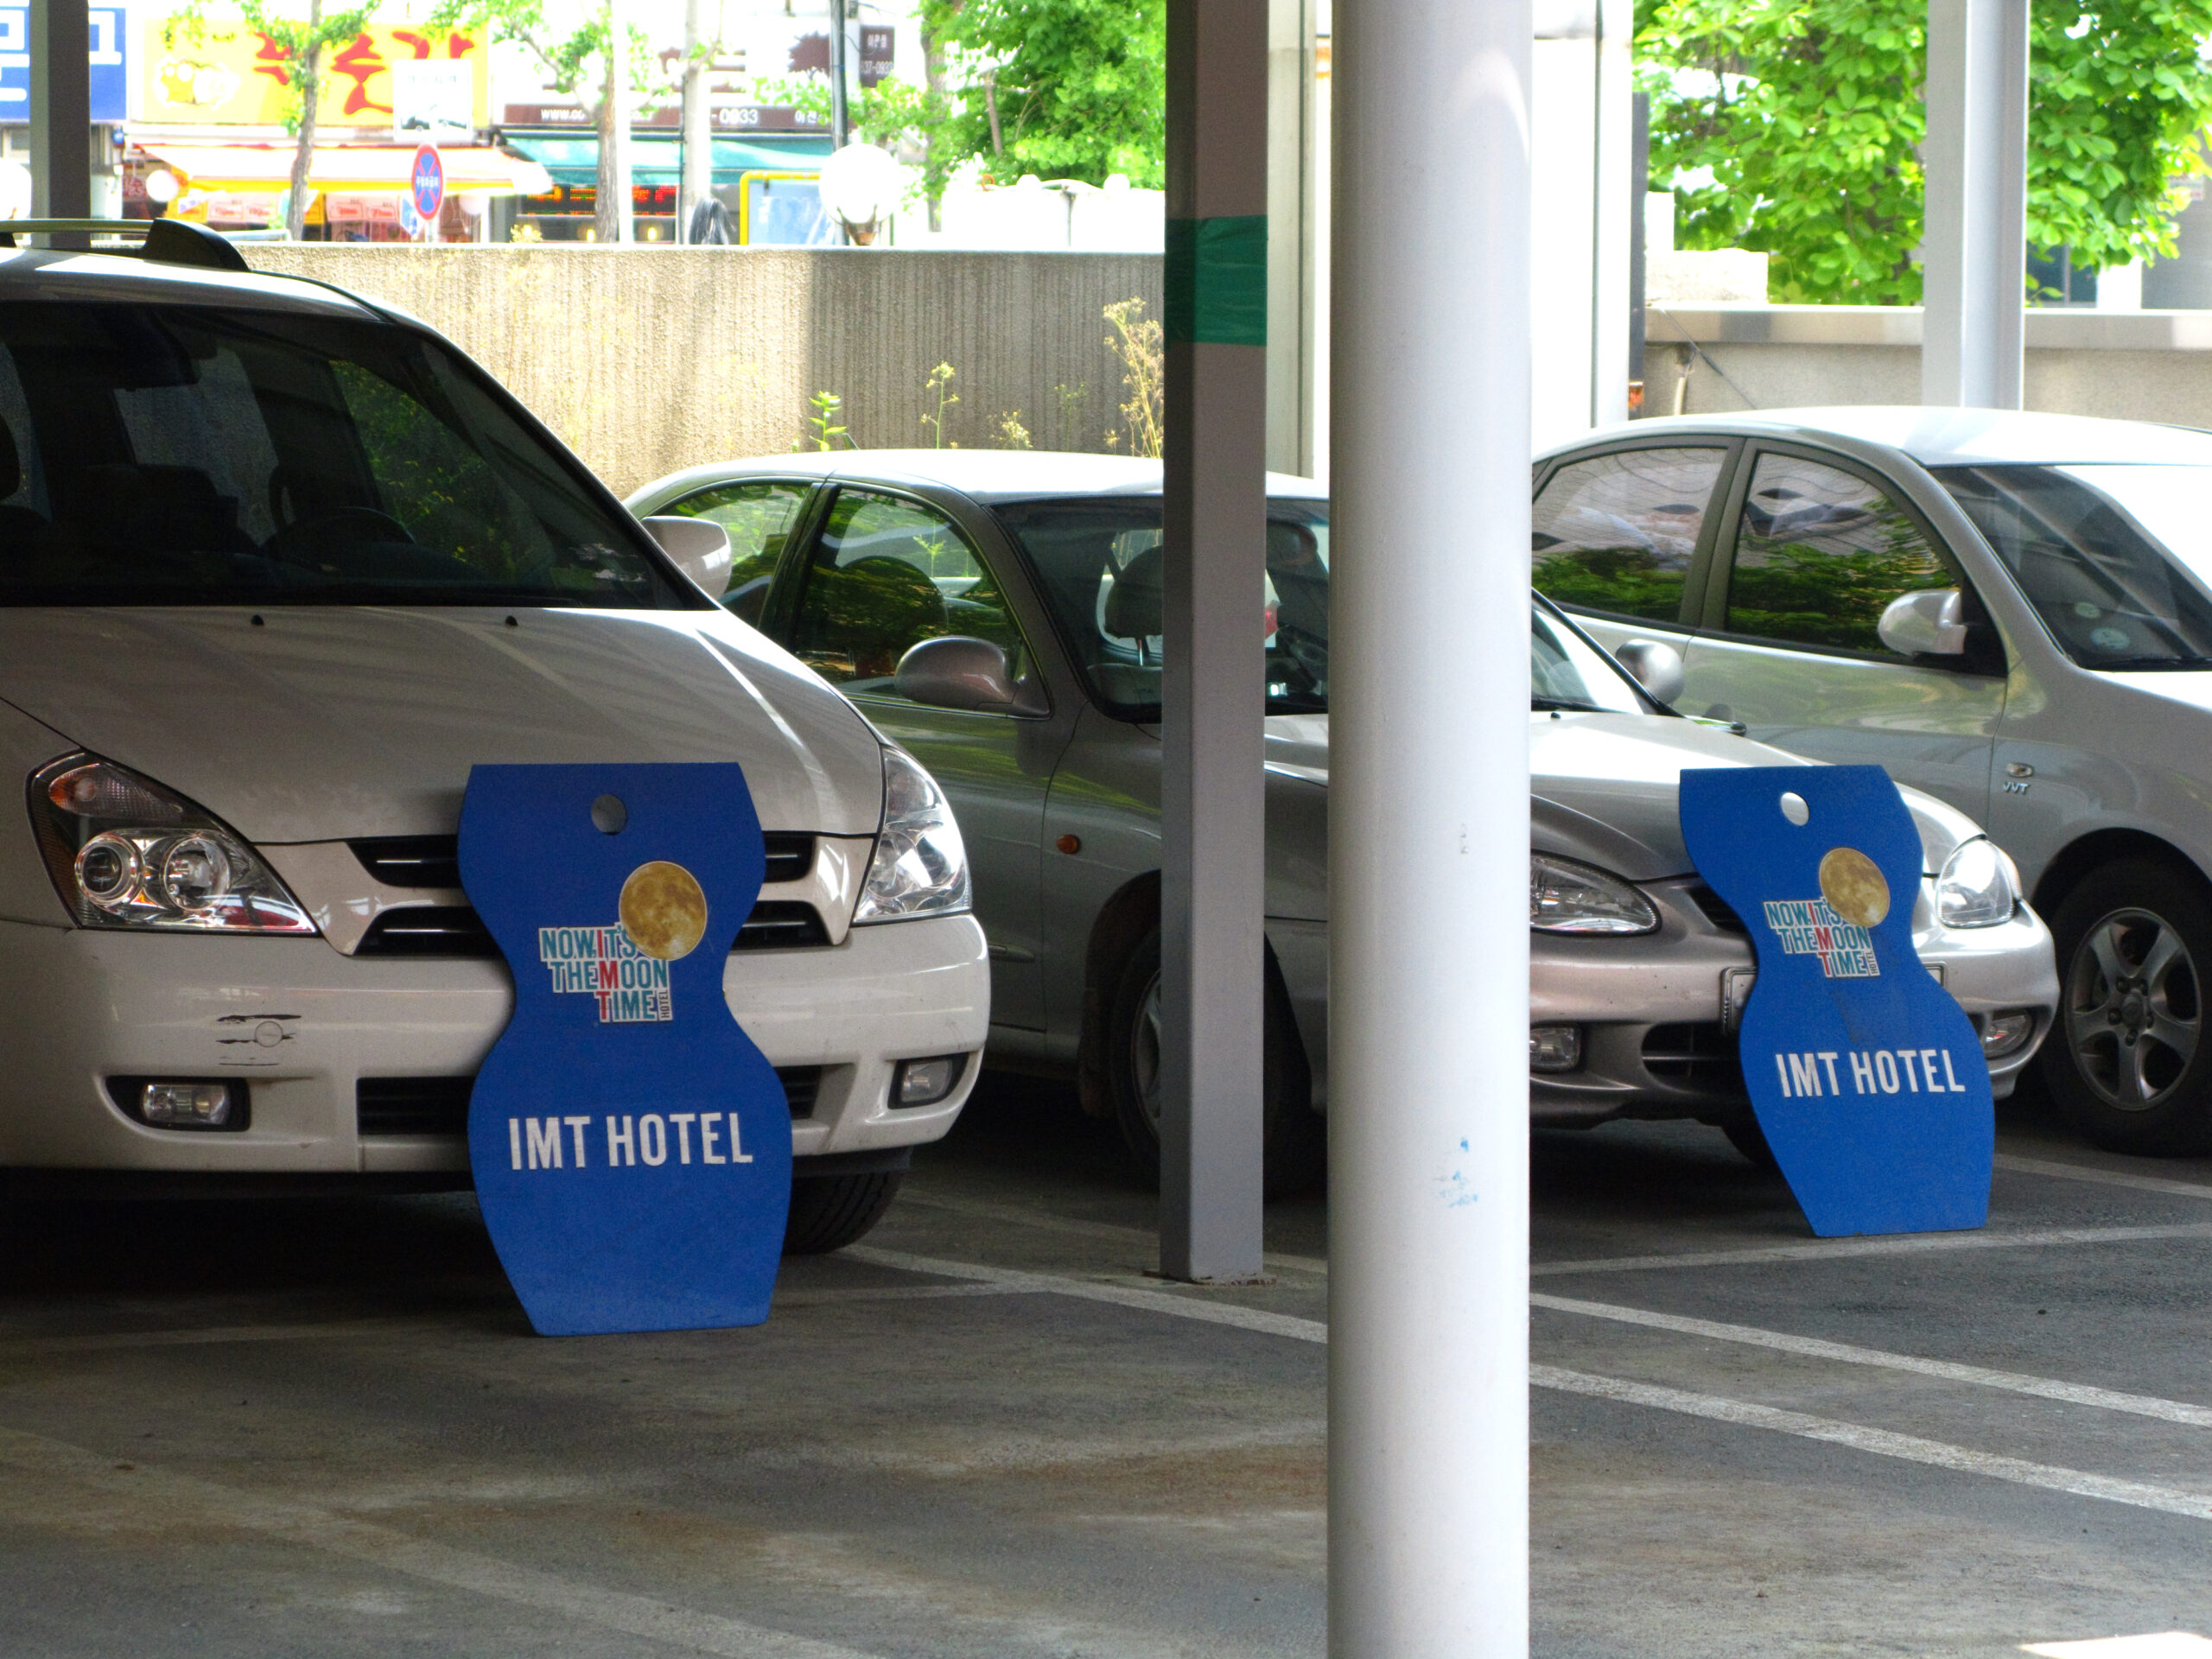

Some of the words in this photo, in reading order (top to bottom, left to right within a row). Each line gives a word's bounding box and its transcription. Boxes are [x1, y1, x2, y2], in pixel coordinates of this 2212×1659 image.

[2003, 781, 2030, 794] VVT
[596, 925, 638, 958] IT'S
[1777, 928, 1817, 951] THE
[1815, 926, 1871, 950] MOON
[550, 961, 597, 990] THE
[599, 959, 668, 989] MOON
[1818, 951, 1866, 975] TIME
[1866, 951, 1878, 975] HOTEL
[595, 990, 656, 1020] TIME
[658, 989, 671, 1018] HOTEL
[1775, 1052, 1840, 1097] IMT
[1849, 1049, 1966, 1095] HOTEL
[508, 1116, 591, 1170] IMT
[606, 1112, 753, 1166] HOTEL
